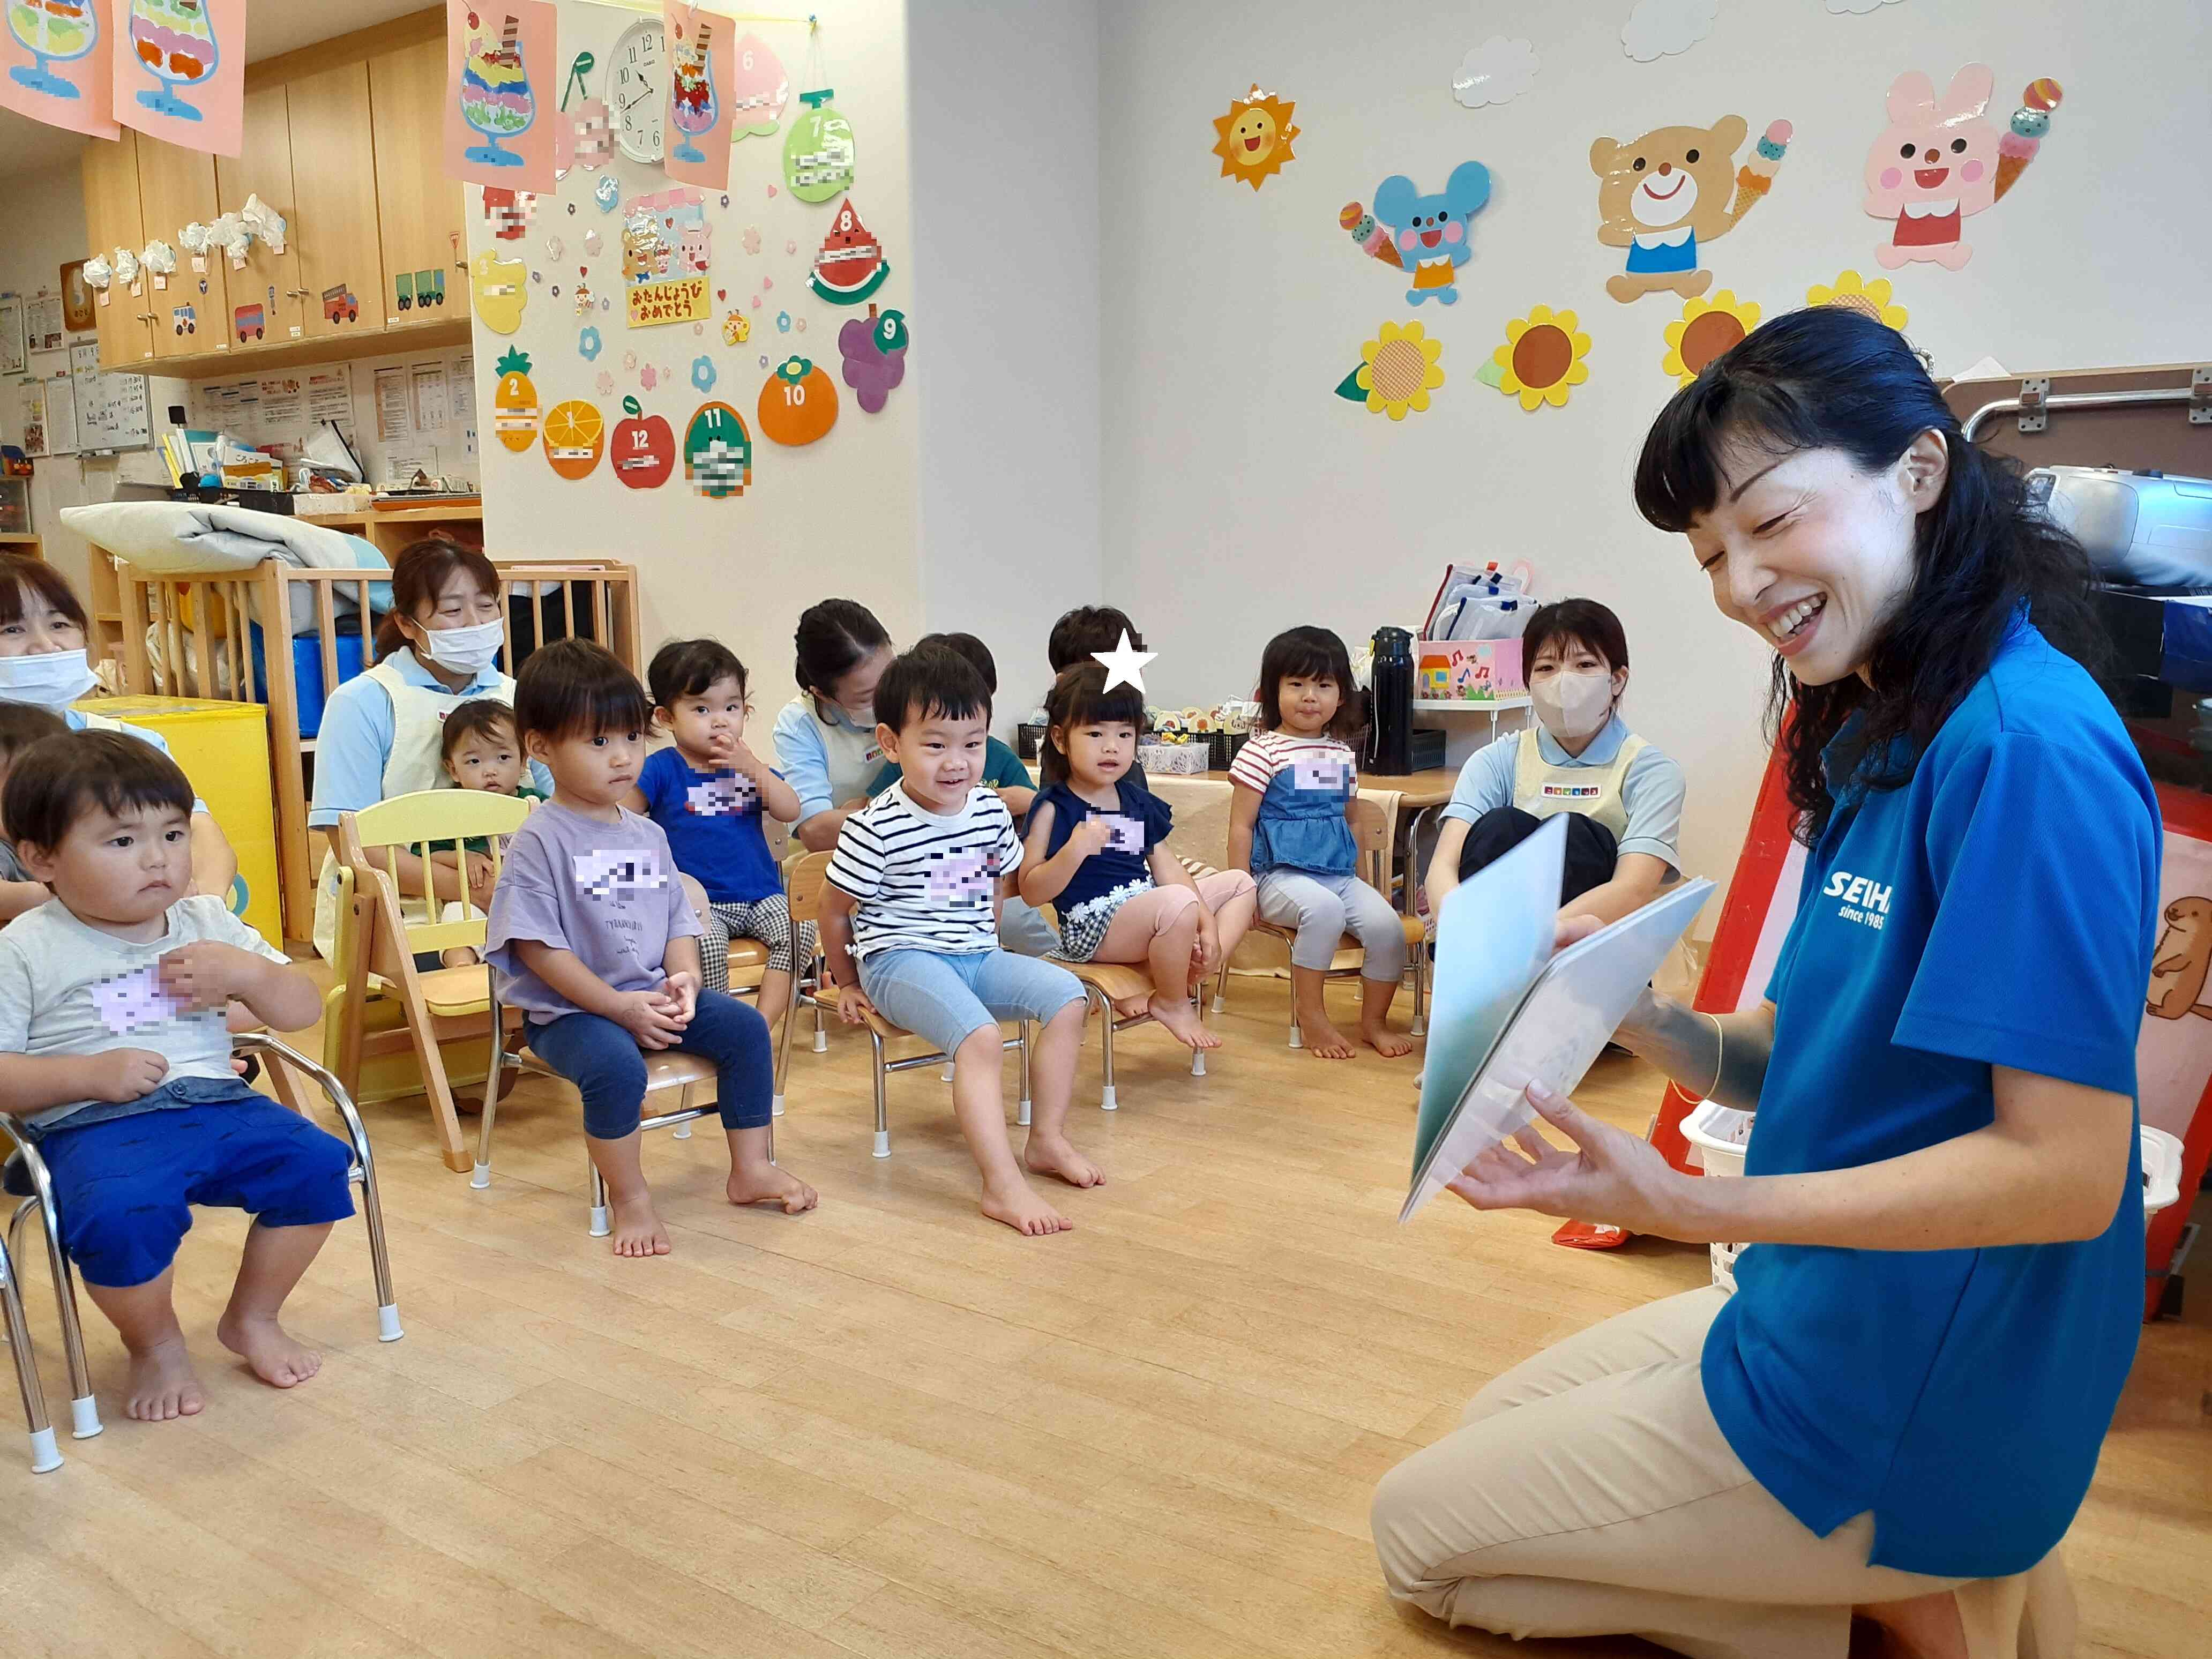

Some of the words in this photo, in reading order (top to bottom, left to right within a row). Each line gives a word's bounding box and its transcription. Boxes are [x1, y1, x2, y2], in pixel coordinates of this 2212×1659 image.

[642, 34, 653, 53] 12
[629, 47, 637, 64] 11
[743, 50, 754, 70] 6
[620, 67, 629, 84] 10
[619, 93, 625, 109] 9
[625, 115, 632, 131] 8
[810, 116, 823, 138] 7
[638, 130, 643, 145] 7
[653, 130, 660, 147] 6
[840, 210, 852, 231] 8
[633, 280, 703, 306] おたんじょうび
[640, 300, 692, 320] おめでとう
[884, 318, 896, 340] 9
[510, 378, 519, 395] 2
[784, 385, 805, 406] 10
[705, 408, 721, 429] 11
[631, 430, 649, 449] 12
[1824, 871, 1892, 914] SEIH
[1839, 905, 1863, 923] since
